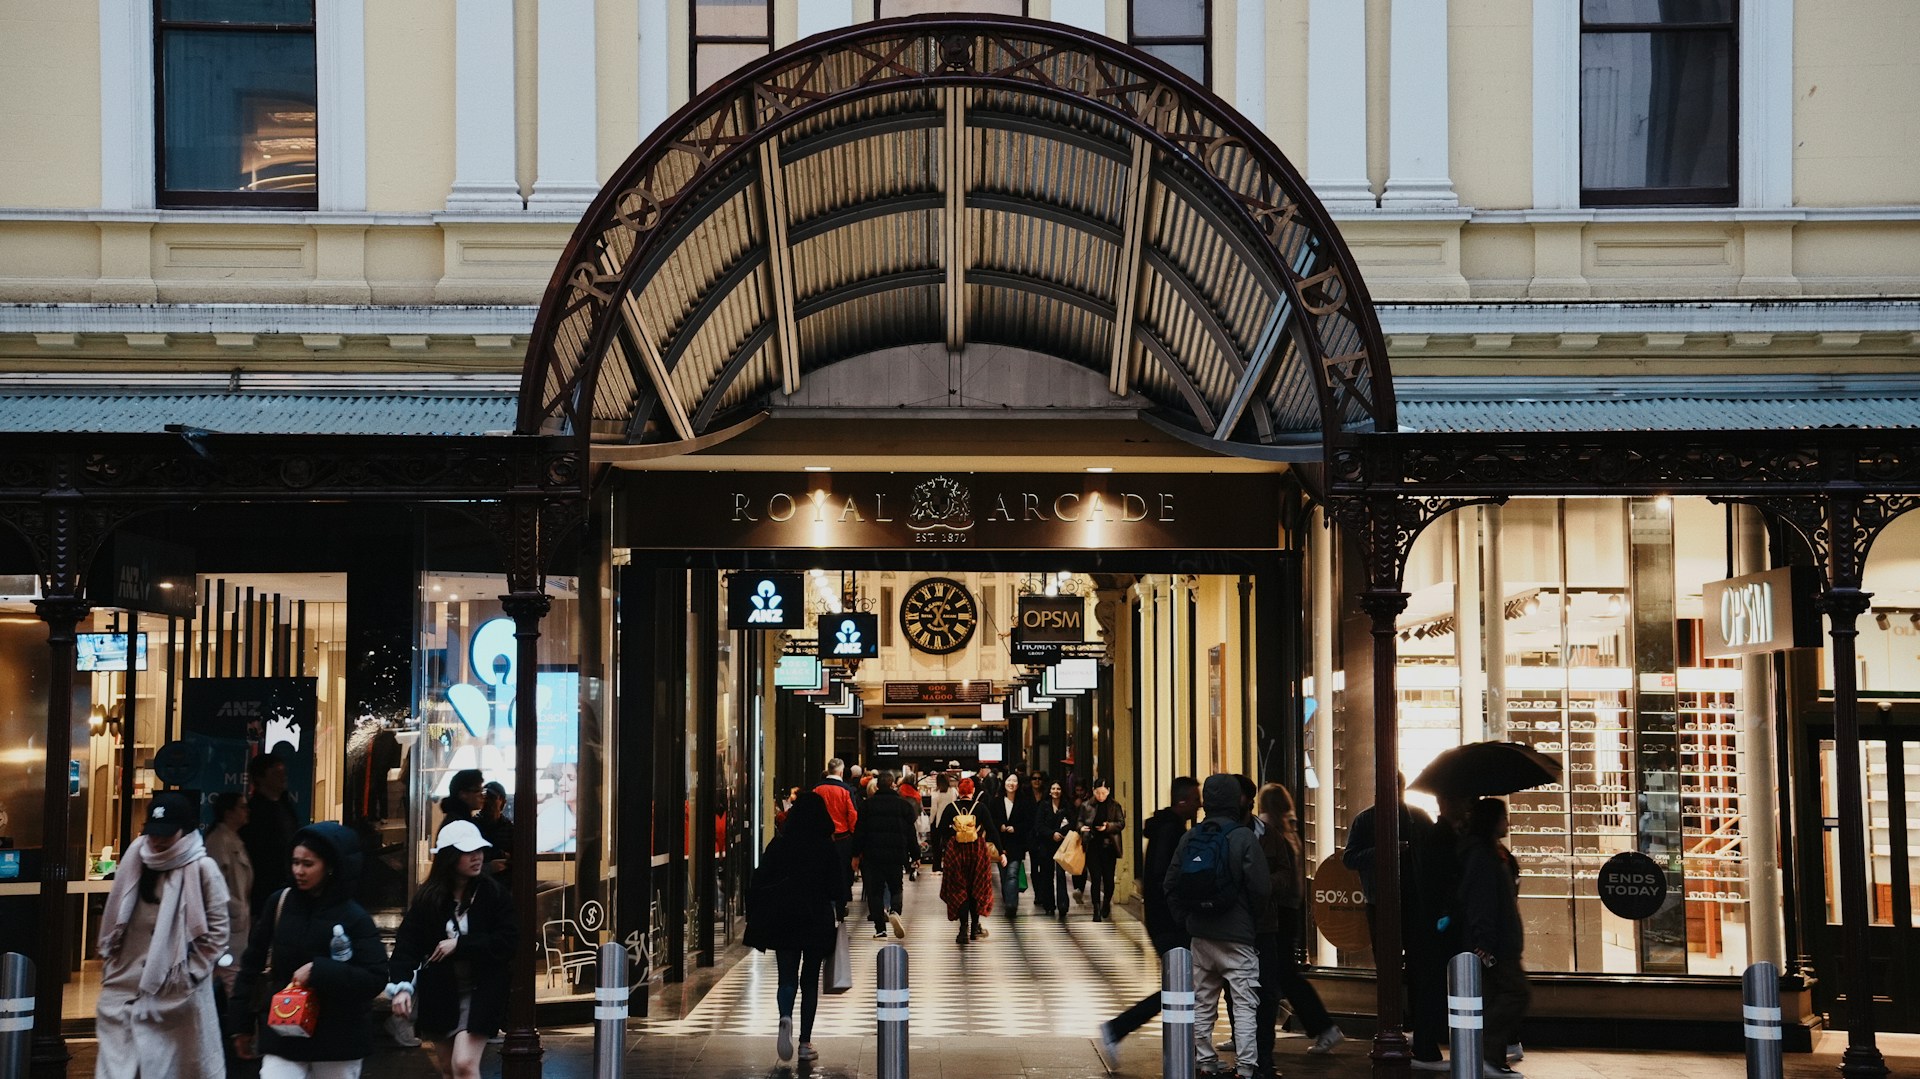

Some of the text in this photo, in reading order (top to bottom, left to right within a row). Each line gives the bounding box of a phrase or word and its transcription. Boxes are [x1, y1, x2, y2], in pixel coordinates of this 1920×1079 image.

[732, 491, 1176, 523] ROYAL ARCADE
[915, 532, 967, 543] EST. 1870
[747, 608, 783, 623] ANZ
[1023, 610, 1080, 628] OPSM
[1720, 582, 1773, 647] OPSM
[833, 642, 862, 654] ANZ
[216, 700, 262, 717] ANZ
[1608, 873, 1656, 884] ENDS
[1315, 889, 1348, 904] 50%
[1604, 885, 1660, 896] TODAY
